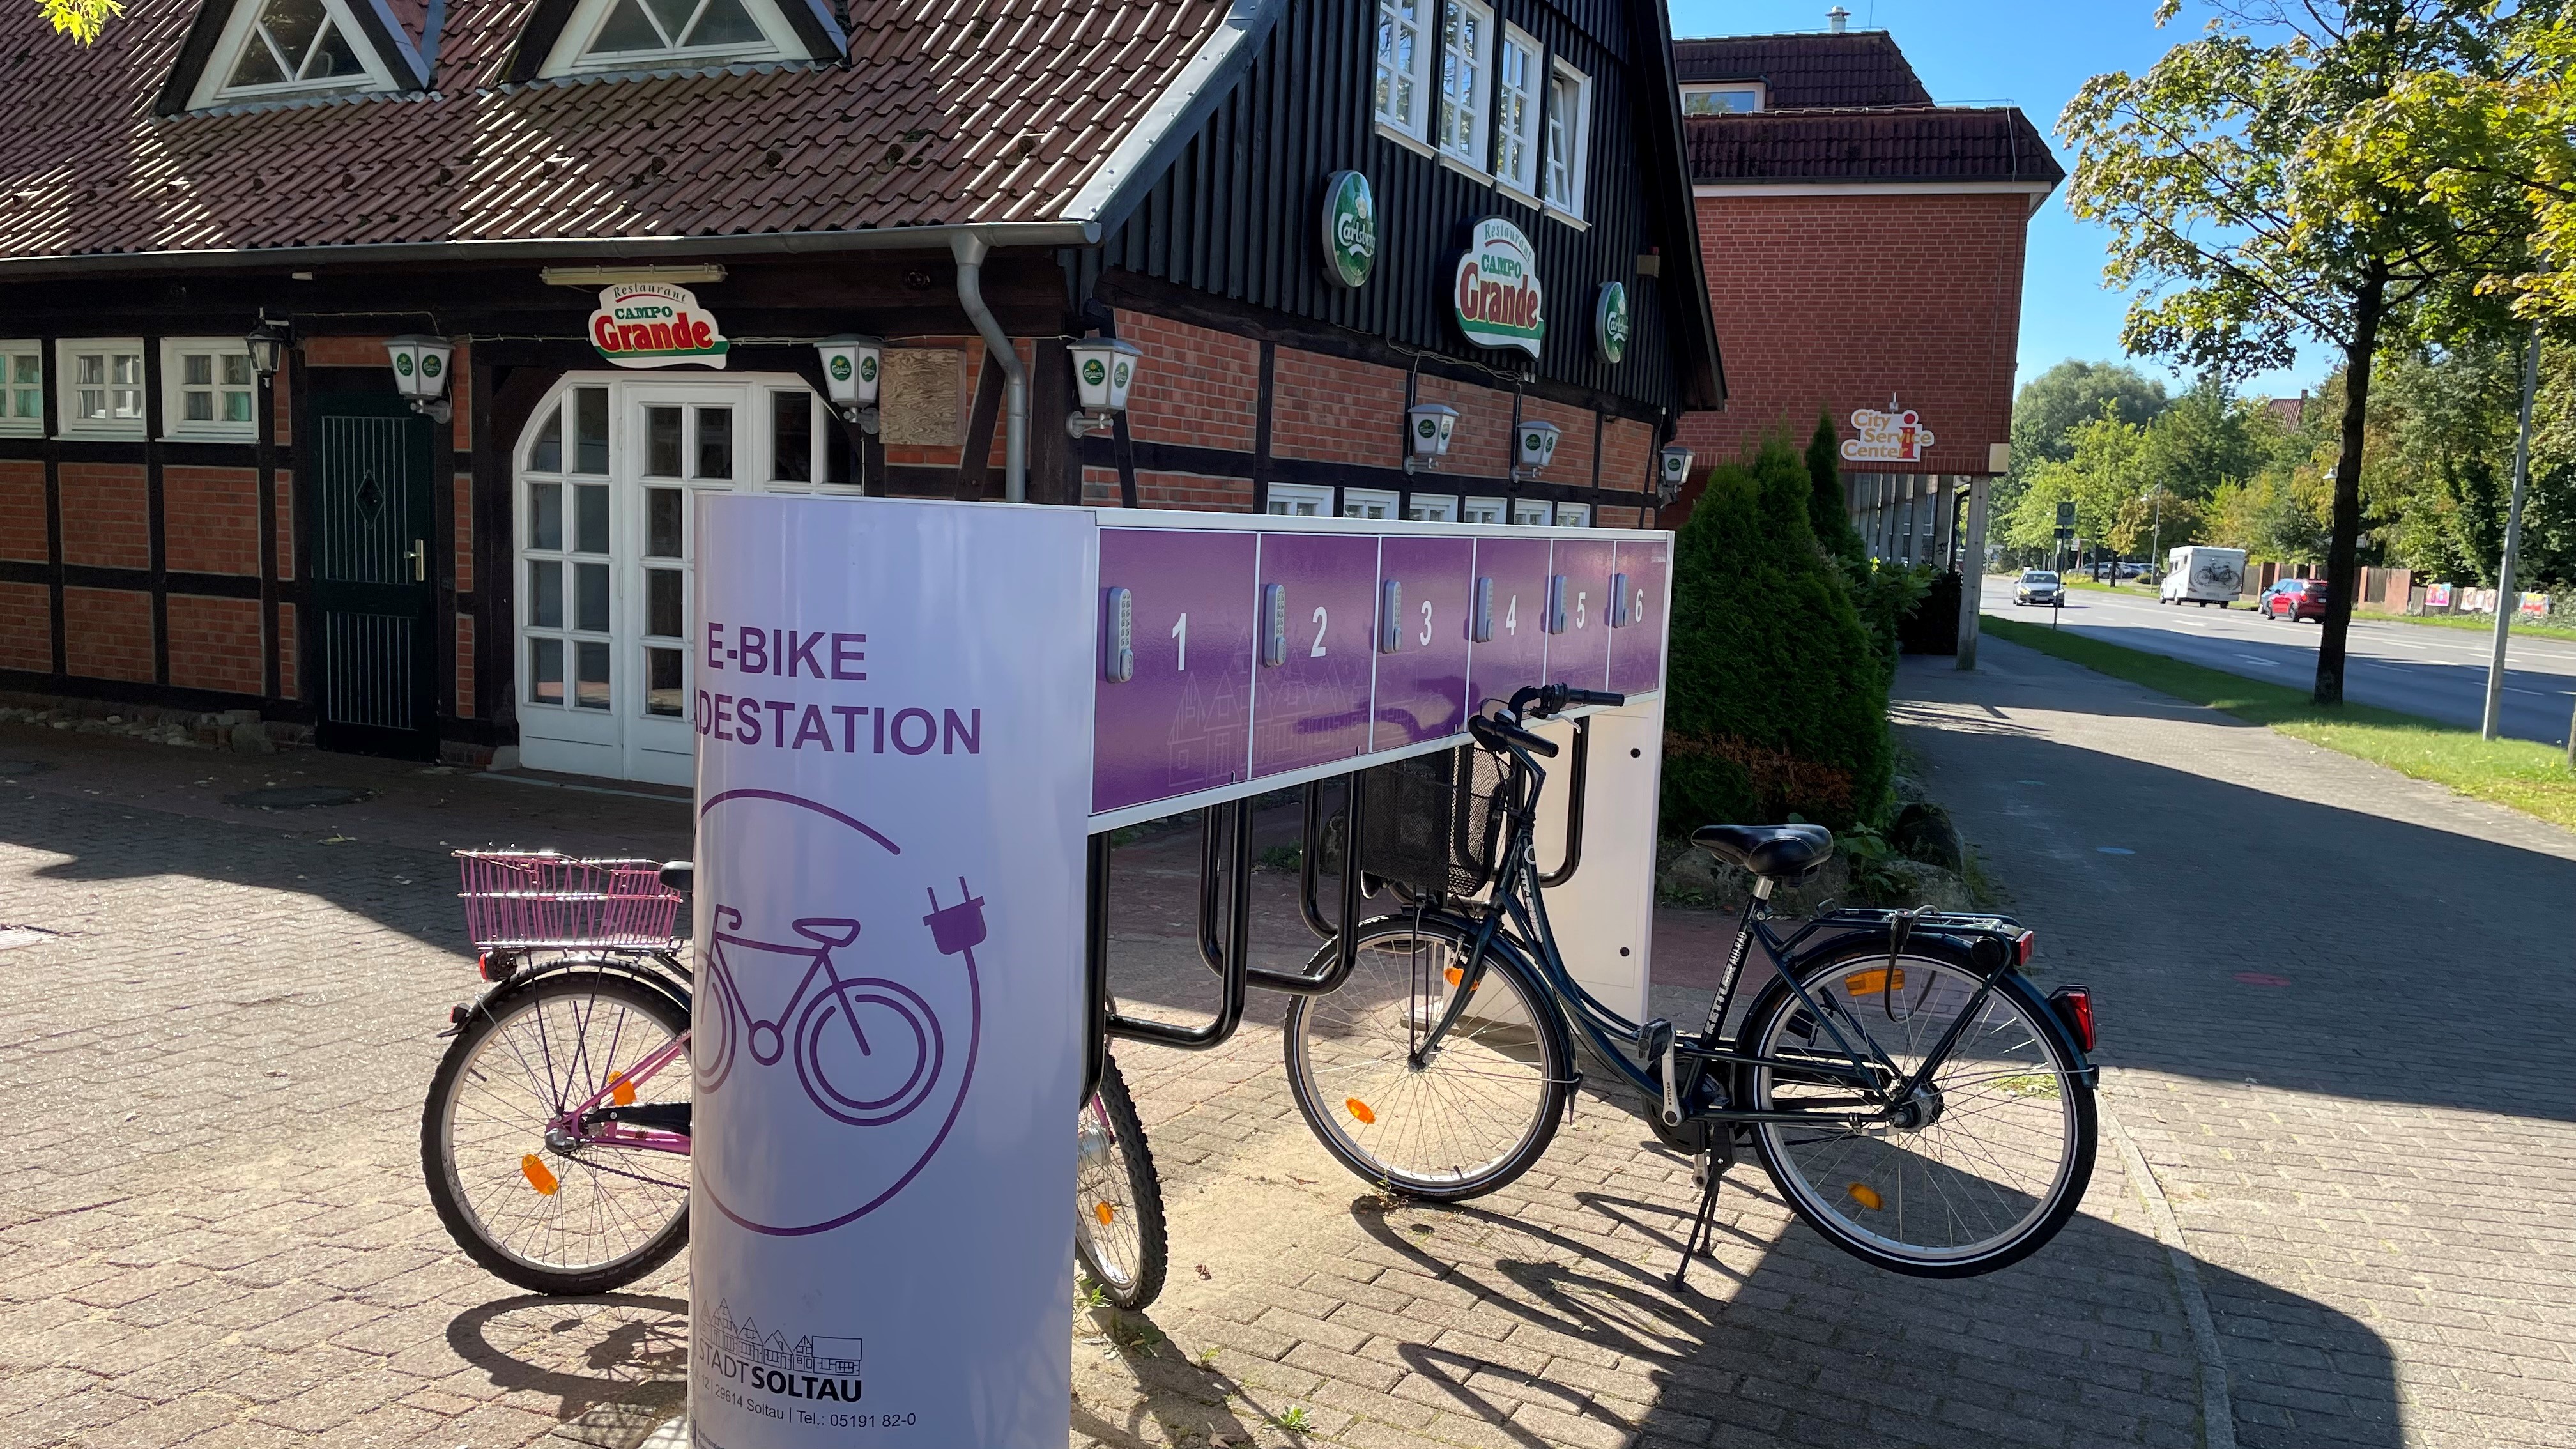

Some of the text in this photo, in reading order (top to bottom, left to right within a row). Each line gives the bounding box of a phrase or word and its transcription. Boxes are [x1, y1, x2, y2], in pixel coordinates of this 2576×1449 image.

[1485, 224, 1532, 261] Restaurant
[1482, 254, 1521, 279] CAMPO
[614, 283, 686, 302] Restaurant
[1460, 262, 1538, 328] Grande
[595, 312, 714, 351] Grande
[615, 306, 673, 319] CAMPO
[1854, 411, 1891, 431] City
[1864, 428, 1931, 444] Service
[1843, 442, 1908, 457] Center
[1420, 601, 1432, 646] 3
[1505, 595, 1517, 636] 4
[1576, 592, 1586, 629] 5
[1636, 588, 1643, 623] 6
[1172, 613, 1187, 671] 1
[1310, 606, 1328, 657] 2
[708, 622, 867, 681] E-BIKE
[1705, 931, 1747, 1035] KETTLER ALU-RAD
[715, 1384, 743, 1408] 29614
[747, 1399, 784, 1420] Soltau
[797, 1409, 825, 1427] Tel.:
[830, 1413, 876, 1428] 05191
[882, 1413, 916, 1427] 82-0
